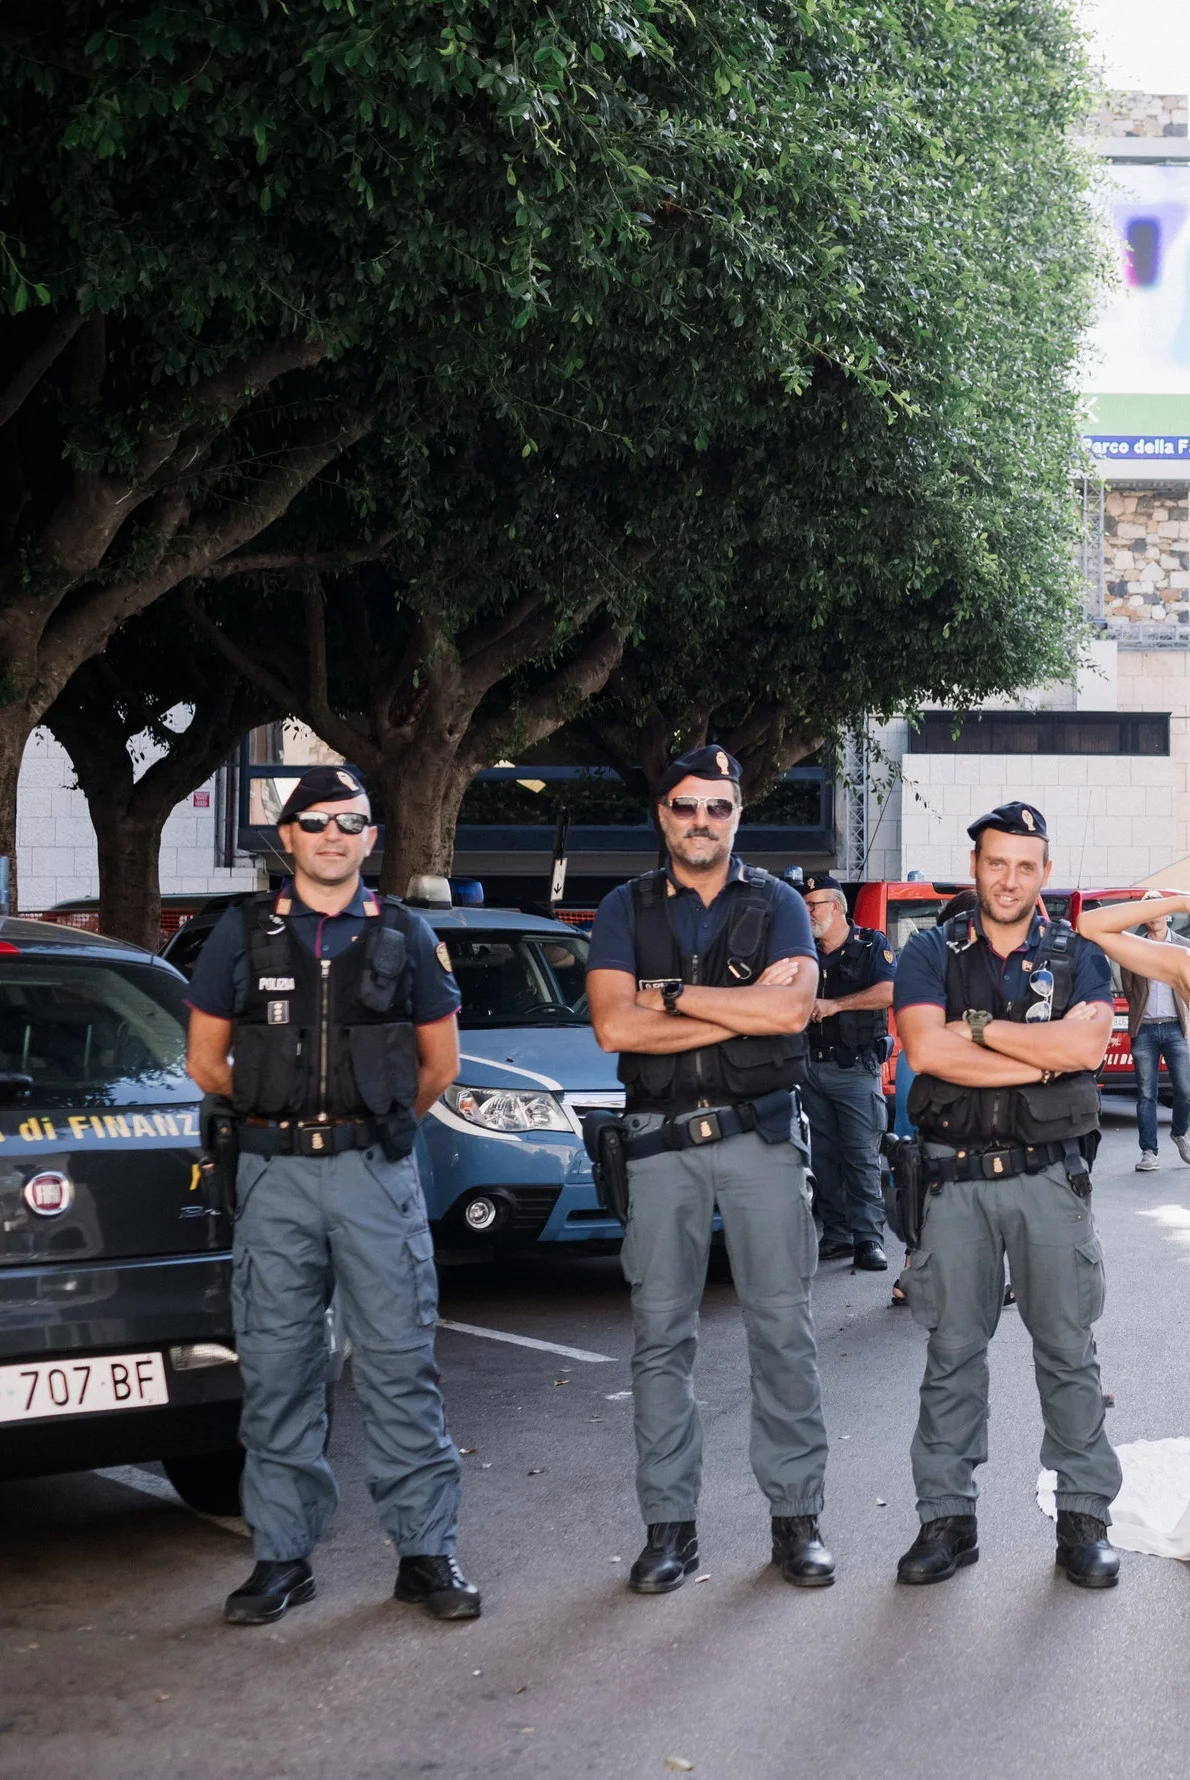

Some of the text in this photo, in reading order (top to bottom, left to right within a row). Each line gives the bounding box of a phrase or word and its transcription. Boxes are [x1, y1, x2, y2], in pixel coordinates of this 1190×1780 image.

[1133, 438, 1175, 455] della
[19, 1117, 57, 1142] di
[67, 1114, 200, 1140] FINANZ
[20, 1361, 153, 1411] 707 BF
